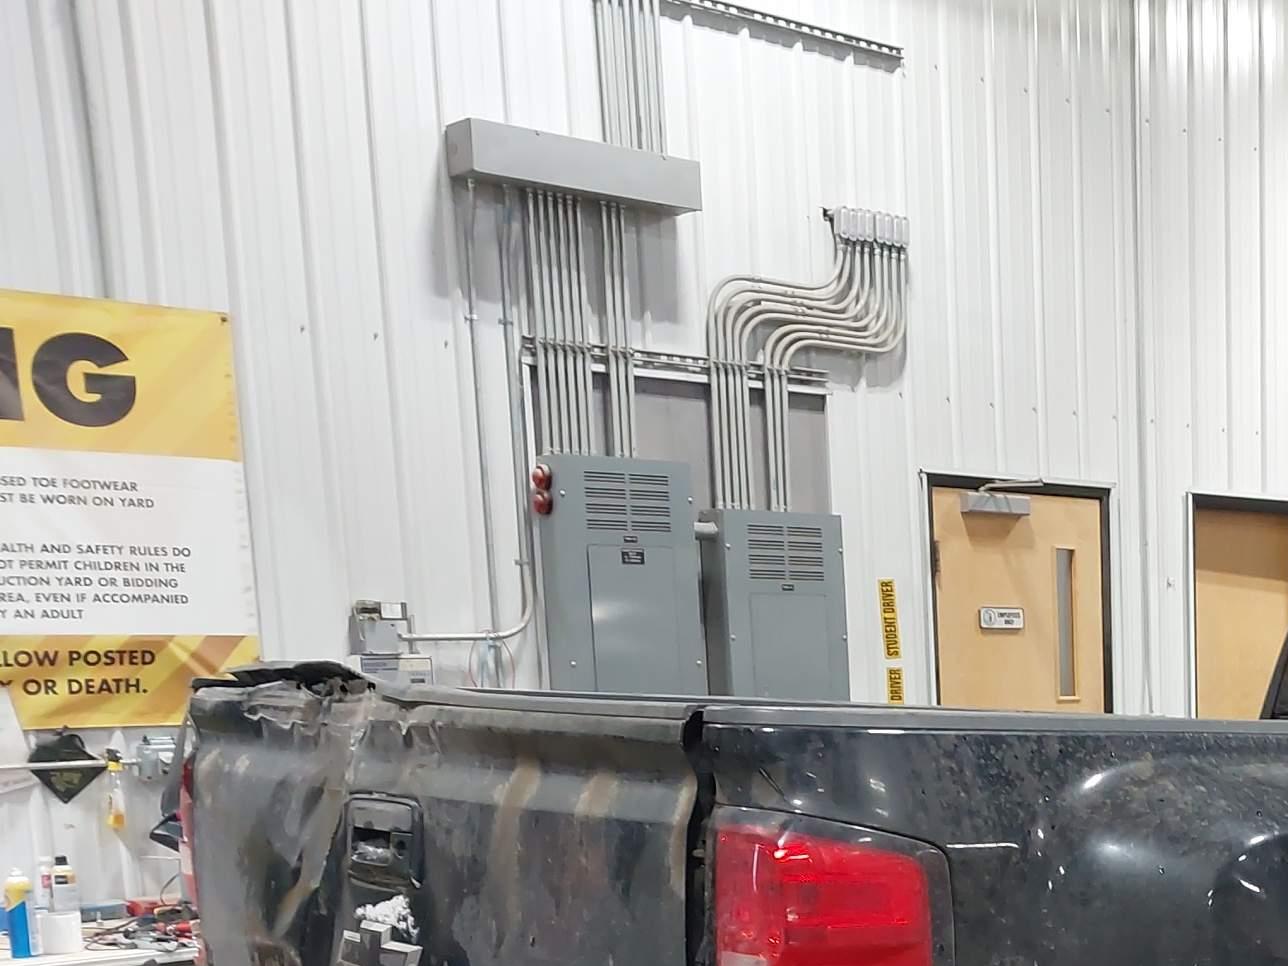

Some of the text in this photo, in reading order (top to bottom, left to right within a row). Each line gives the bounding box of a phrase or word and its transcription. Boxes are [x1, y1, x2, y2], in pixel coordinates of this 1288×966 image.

[31, 477, 57, 488] TOE
[62, 478, 139, 492] FOOTWEAR
[19, 493, 36, 504] BE
[40, 494, 88, 506] WORN
[92, 496, 115, 507] ON
[119, 497, 155, 509] YARD
[40, 543, 72, 554] AND
[76, 544, 125, 556] SAFETY
[129, 545, 168, 557] RULES
[172, 547, 192, 558] DO
[19, 559, 69, 571] PERMIT
[73, 560, 140, 572] CHILDREN
[144, 562, 160, 573] IN
[163, 562, 186, 574] THE
[56, 576, 93, 587] YARD
[97, 577, 118, 588] OR
[123, 577, 179, 589] BIDDING
[35, 592, 71, 603] EVEN
[76, 593, 87, 603] IF
[92, 593, 189, 605] ACCOMPANIED
[13, 609, 35, 620] AN
[40, 609, 85, 620] ADULT
[880, 580, 900, 657] STUDENT DRIVER
[68, 650, 156, 667] POSTED
[22, 678, 59, 696] OR
[67, 677, 149, 695] DEATH.
[889, 668, 903, 701] DRIVER
